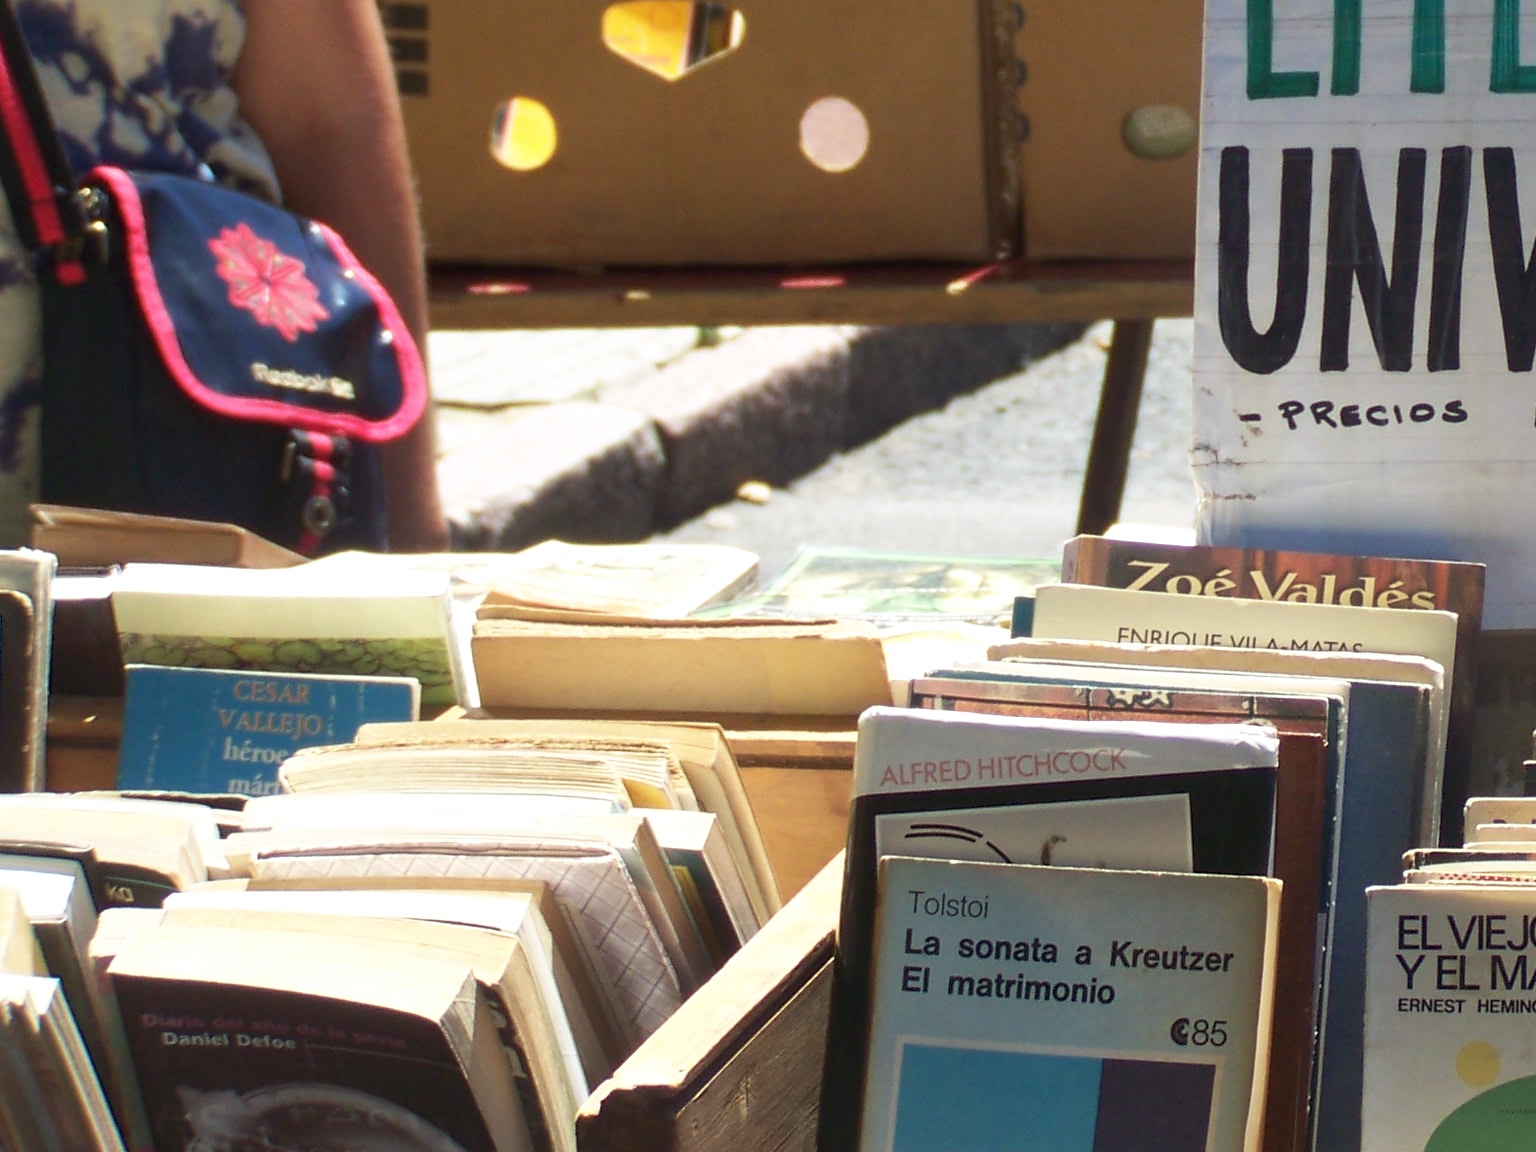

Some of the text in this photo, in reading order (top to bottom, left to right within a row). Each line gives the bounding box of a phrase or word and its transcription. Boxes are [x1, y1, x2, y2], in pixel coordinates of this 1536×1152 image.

[1122, 560, 1436, 611] Zoé Valdés
[218, 708, 325, 741] VALLEJO
[880, 746, 1127, 786] ALFRED HITCHCOCK
[908, 890, 990, 919] Tolstoi
[904, 928, 1235, 973] La sonata a Kreutzer
[1398, 915, 1442, 950] EL
[901, 966, 1116, 1005] El matrimonio
[1396, 954, 1426, 990] Y
[1436, 955, 1480, 991] EL
[1398, 999, 1466, 1014] ERNEST
[161, 1030, 297, 1050] Daniel Defoe
